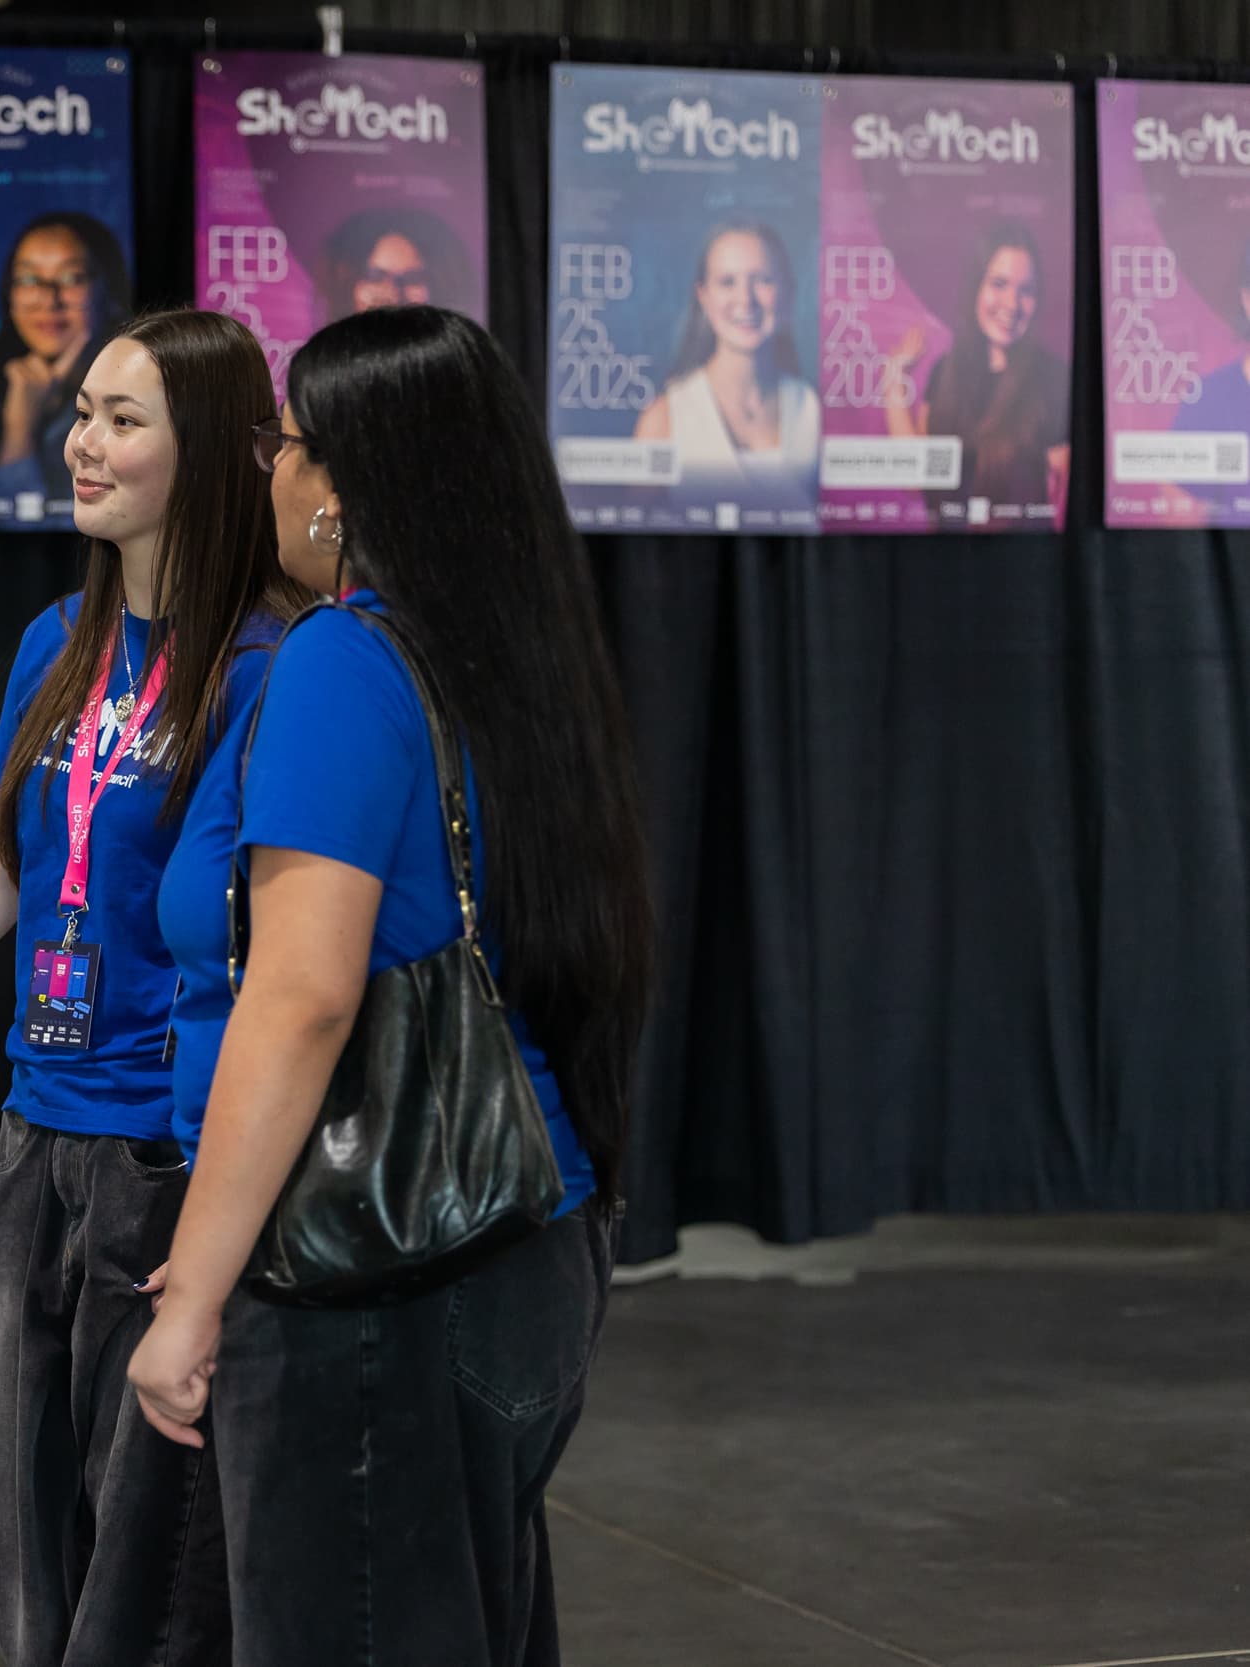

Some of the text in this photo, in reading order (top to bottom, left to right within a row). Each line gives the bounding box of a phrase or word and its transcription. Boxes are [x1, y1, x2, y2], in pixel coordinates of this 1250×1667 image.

[236, 83, 448, 143] SheTech
[582, 97, 799, 160] SheTech
[851, 107, 1040, 163] SheTech
[208, 224, 289, 283] FEB
[558, 243, 633, 300] FEB
[823, 245, 896, 299] FEB
[1110, 245, 1178, 298] FEB
[557, 353, 655, 410] 2025
[823, 352, 917, 408] 2025
[1113, 350, 1203, 404] 2025
